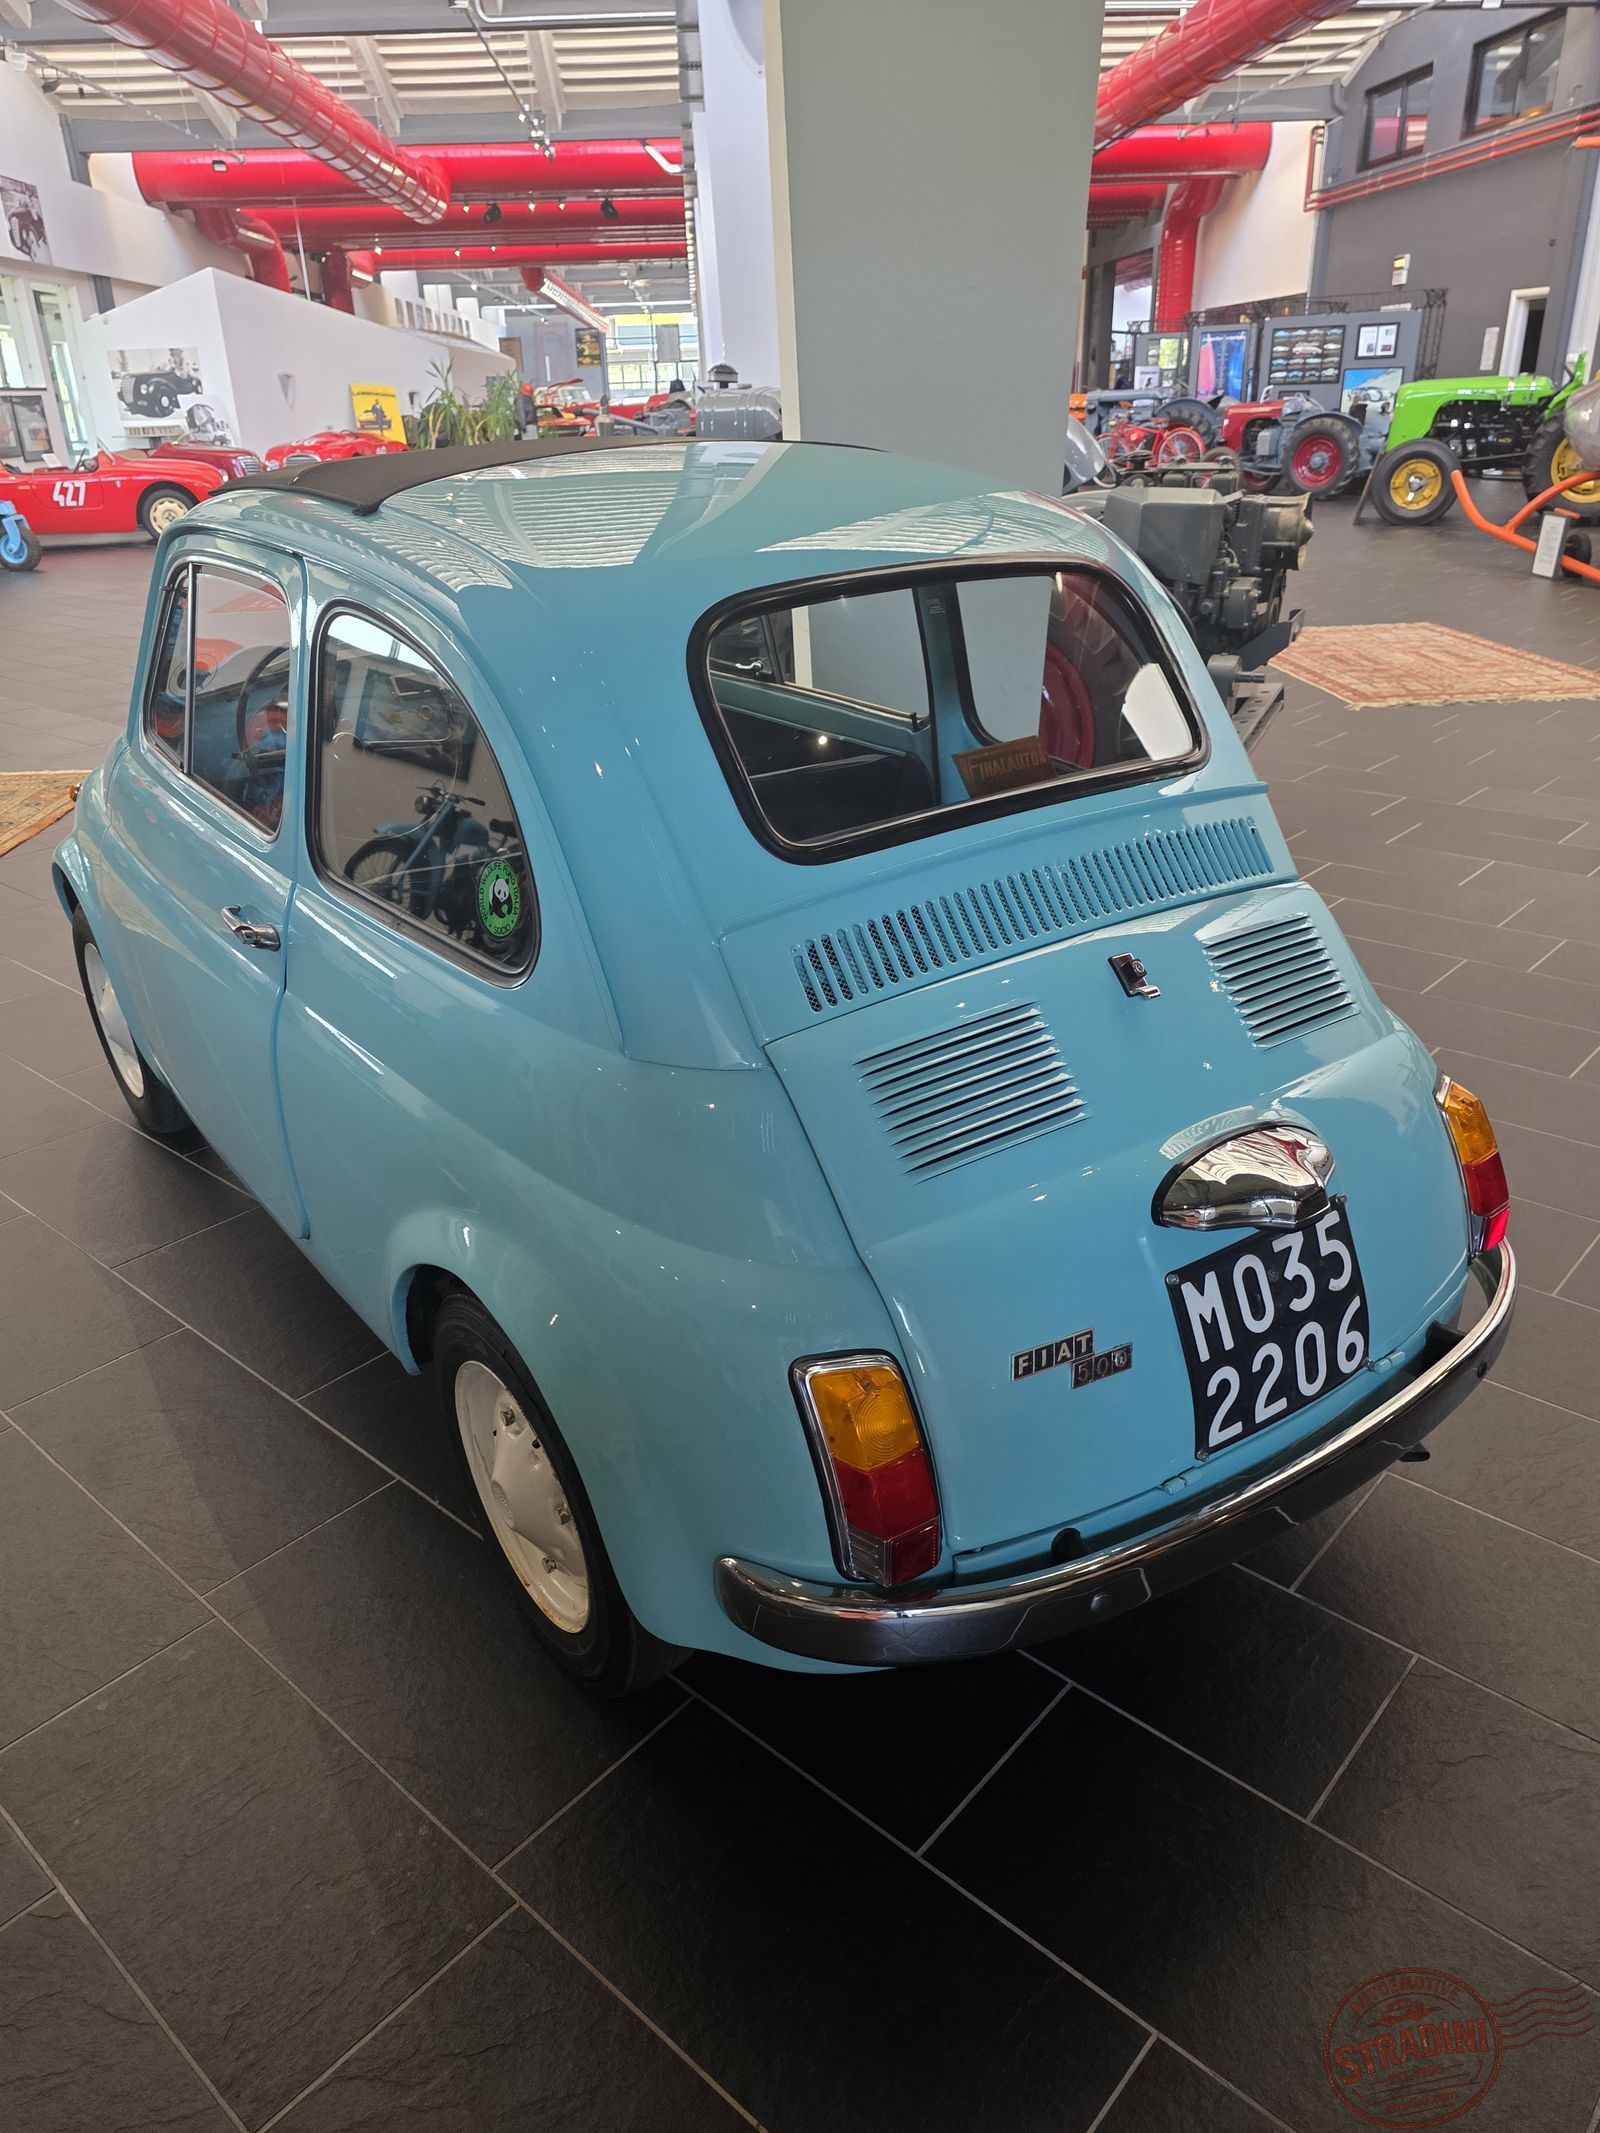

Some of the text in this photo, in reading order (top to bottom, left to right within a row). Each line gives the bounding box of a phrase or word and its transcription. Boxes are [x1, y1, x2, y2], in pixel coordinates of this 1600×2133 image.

[52, 480, 86, 507] 427
[1018, 1334, 1091, 1376] FIAT
[1078, 1350, 1128, 1382] 500
[1206, 1295, 1365, 1448] 2206
